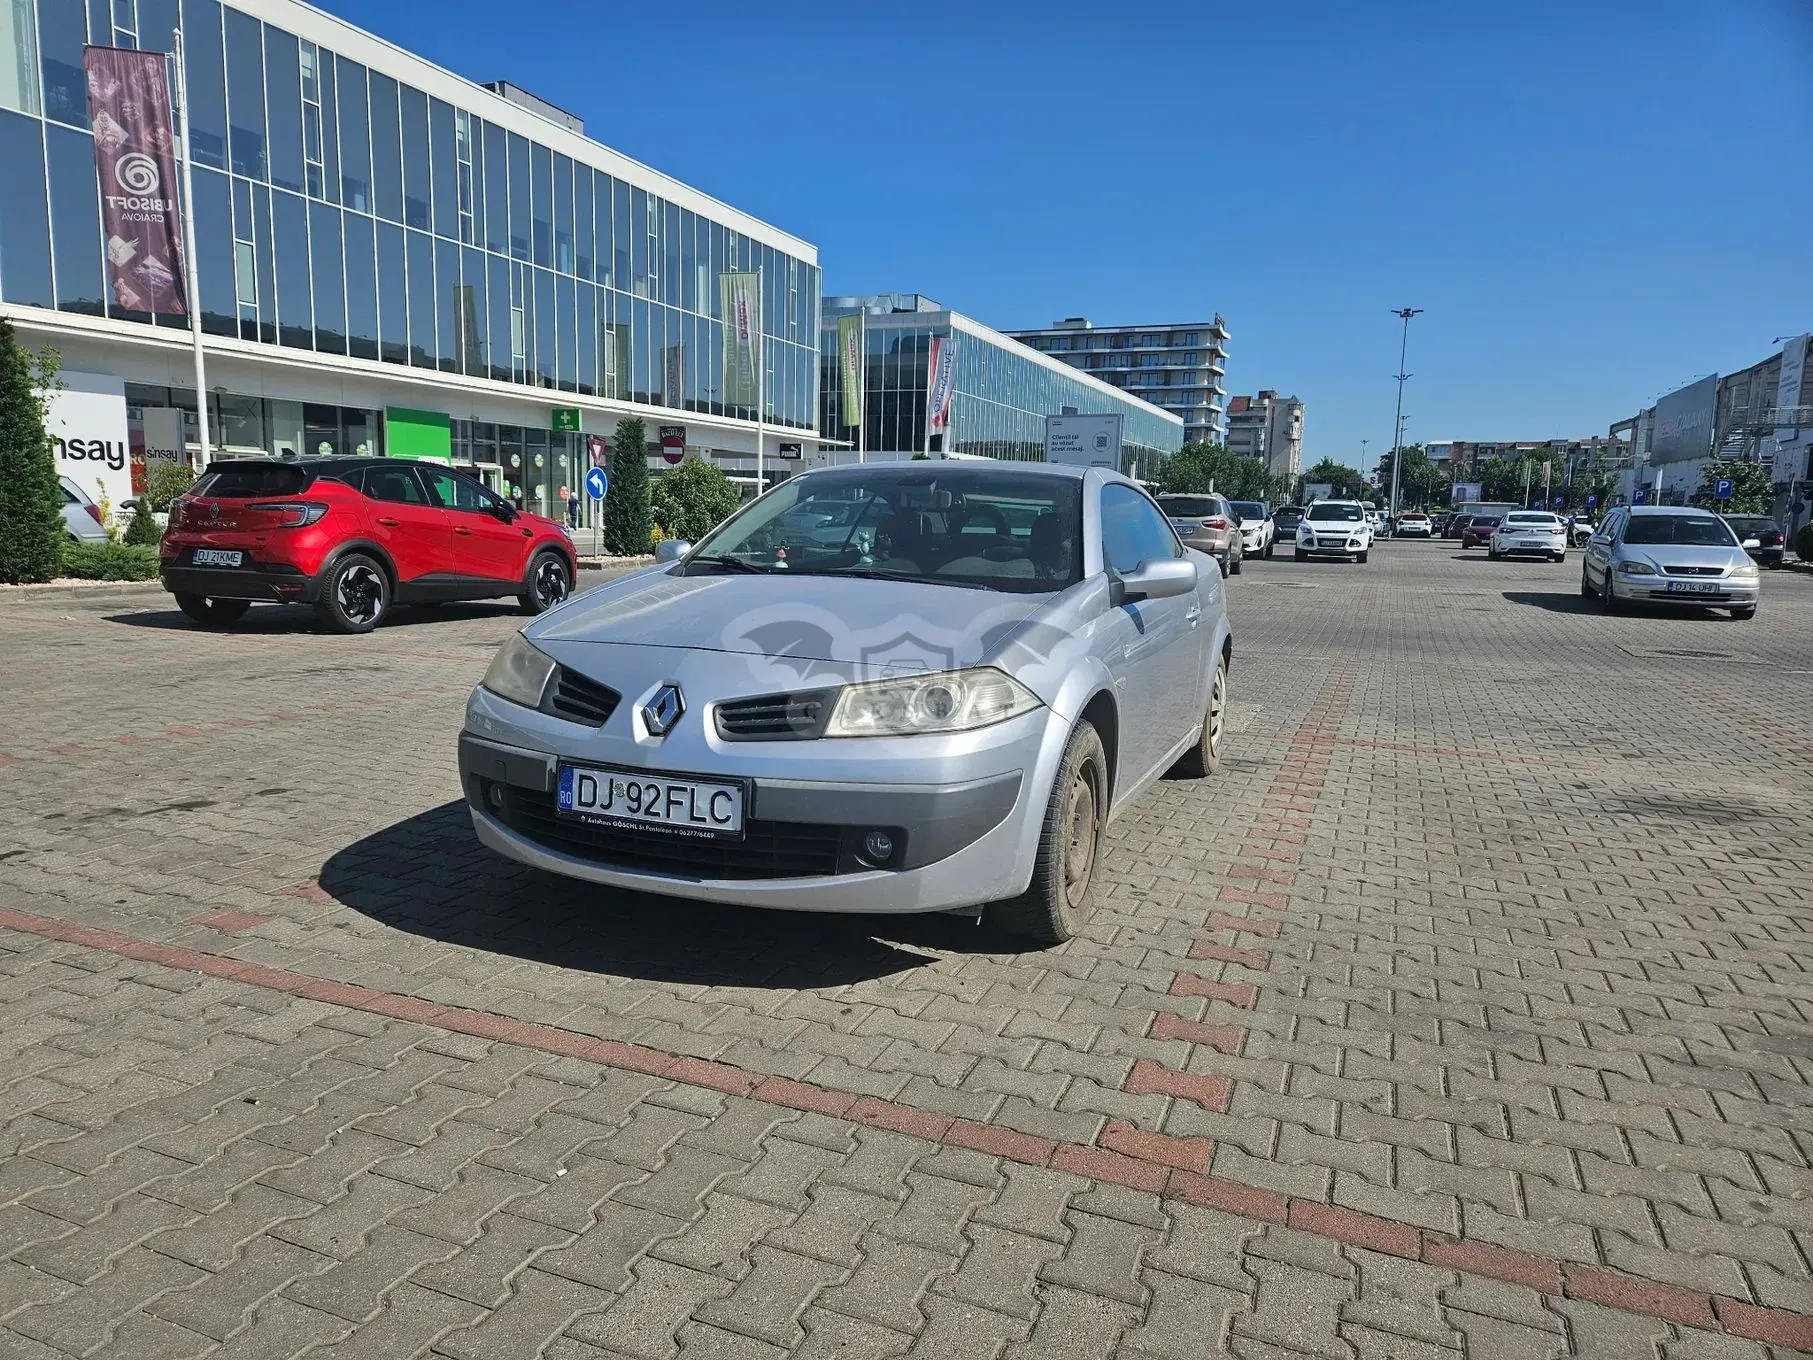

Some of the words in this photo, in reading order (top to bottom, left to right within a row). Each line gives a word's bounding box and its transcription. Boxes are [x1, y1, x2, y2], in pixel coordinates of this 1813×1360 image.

[56, 438, 125, 471] nsay
[146, 446, 178, 463] sinsay
[1718, 481, 1729, 493] P
[1555, 497, 1562, 505] P
[1588, 496, 1595, 504] P
[1635, 490, 1644, 501] P
[198, 551, 209, 561] DJ
[560, 790, 572, 805] RO
[577, 773, 614, 810] DJ
[587, 818, 612, 827] Autohaus
[612, 820, 638, 830] GÖSCHL
